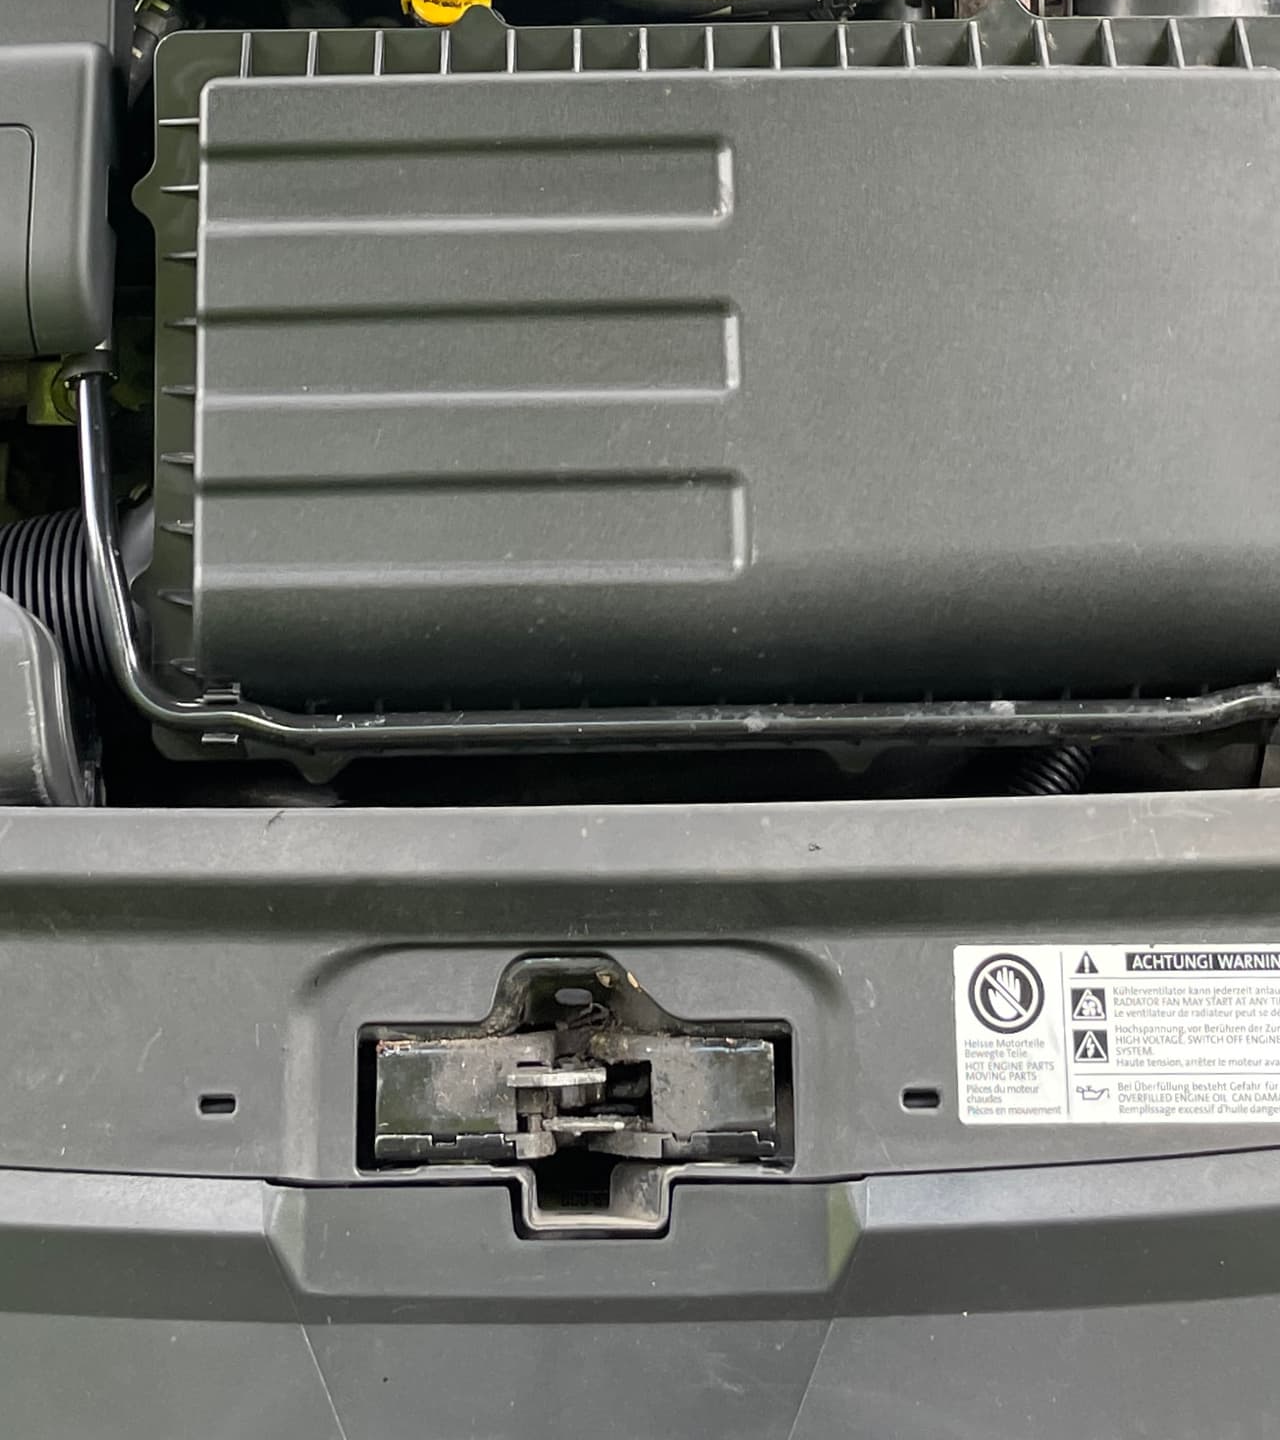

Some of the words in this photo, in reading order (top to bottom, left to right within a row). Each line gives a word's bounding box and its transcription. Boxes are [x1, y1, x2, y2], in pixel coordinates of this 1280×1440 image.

[1132, 954, 1214, 970] ACHTUNG!
[1112, 986, 1186, 996] Kühlerventilator
[1188, 986, 1210, 995] kann
[1212, 986, 1252, 998] jederzeit
[1114, 997, 1160, 1006] RADIATOR
[1162, 997, 1180, 1006] FAN
[1182, 997, 1204, 1006] MAY
[1205, 997, 1232, 1006] START
[1235, 997, 1247, 1006] AT
[1248, 997, 1268, 1006] ANY
[1114, 1009, 1124, 1018] Le
[1126, 1008, 1176, 1018] ventilateur
[1178, 1009, 1188, 1018] de
[1191, 1008, 1233, 1018] radiateur
[1235, 1008, 1256, 1019] peut
[1188, 1026, 1201, 1034] vor
[1204, 1024, 1246, 1034] Berühren
[1248, 1024, 1262, 1033] der
[964, 1040, 994, 1048] Heisse
[996, 1039, 1045, 1048] Motorteile
[1116, 1036, 1140, 1044] HIGH
[1188, 1035, 1224, 1044] SWITCH
[1226, 1035, 1244, 1044] OFF
[1246, 1035, 1280, 1044] ENGINE
[964, 1049, 1005, 1060] Bewegte
[1007, 1048, 1028, 1058] Teile
[965, 1062, 985, 1071] HOT
[988, 1062, 1024, 1071] ENGINE
[1026, 1061, 1055, 1071] PARTS
[1116, 1058, 1144, 1067] Haute
[1185, 1058, 1218, 1067] arrêter
[1219, 1058, 1230, 1066] le
[1231, 1058, 1262, 1066] moteur
[965, 1072, 1006, 1081] MOVING
[1008, 1072, 1037, 1081] PARTS
[994, 1084, 1006, 1094] du
[1007, 1085, 1039, 1094] moteur
[1118, 1082, 1132, 1091] Bei
[1134, 1080, 1188, 1094] Überfüllung
[1192, 1081, 1227, 1091] besteht
[1230, 1081, 1260, 1090] Gefahr
[1265, 1081, 1278, 1090] für
[966, 1095, 1002, 1104] chaudes
[1120, 1093, 1172, 1102] OVERFILLED
[1174, 1093, 1210, 1102] ENGINE
[1212, 1093, 1228, 1102] OIL
[1232, 1093, 1252, 1102] CAN
[1008, 1106, 1062, 1115] mouvement
[1120, 1105, 1176, 1116] Remplissage
[1178, 1105, 1215, 1114] excessif
[1217, 1105, 1248, 1114] d'huile
